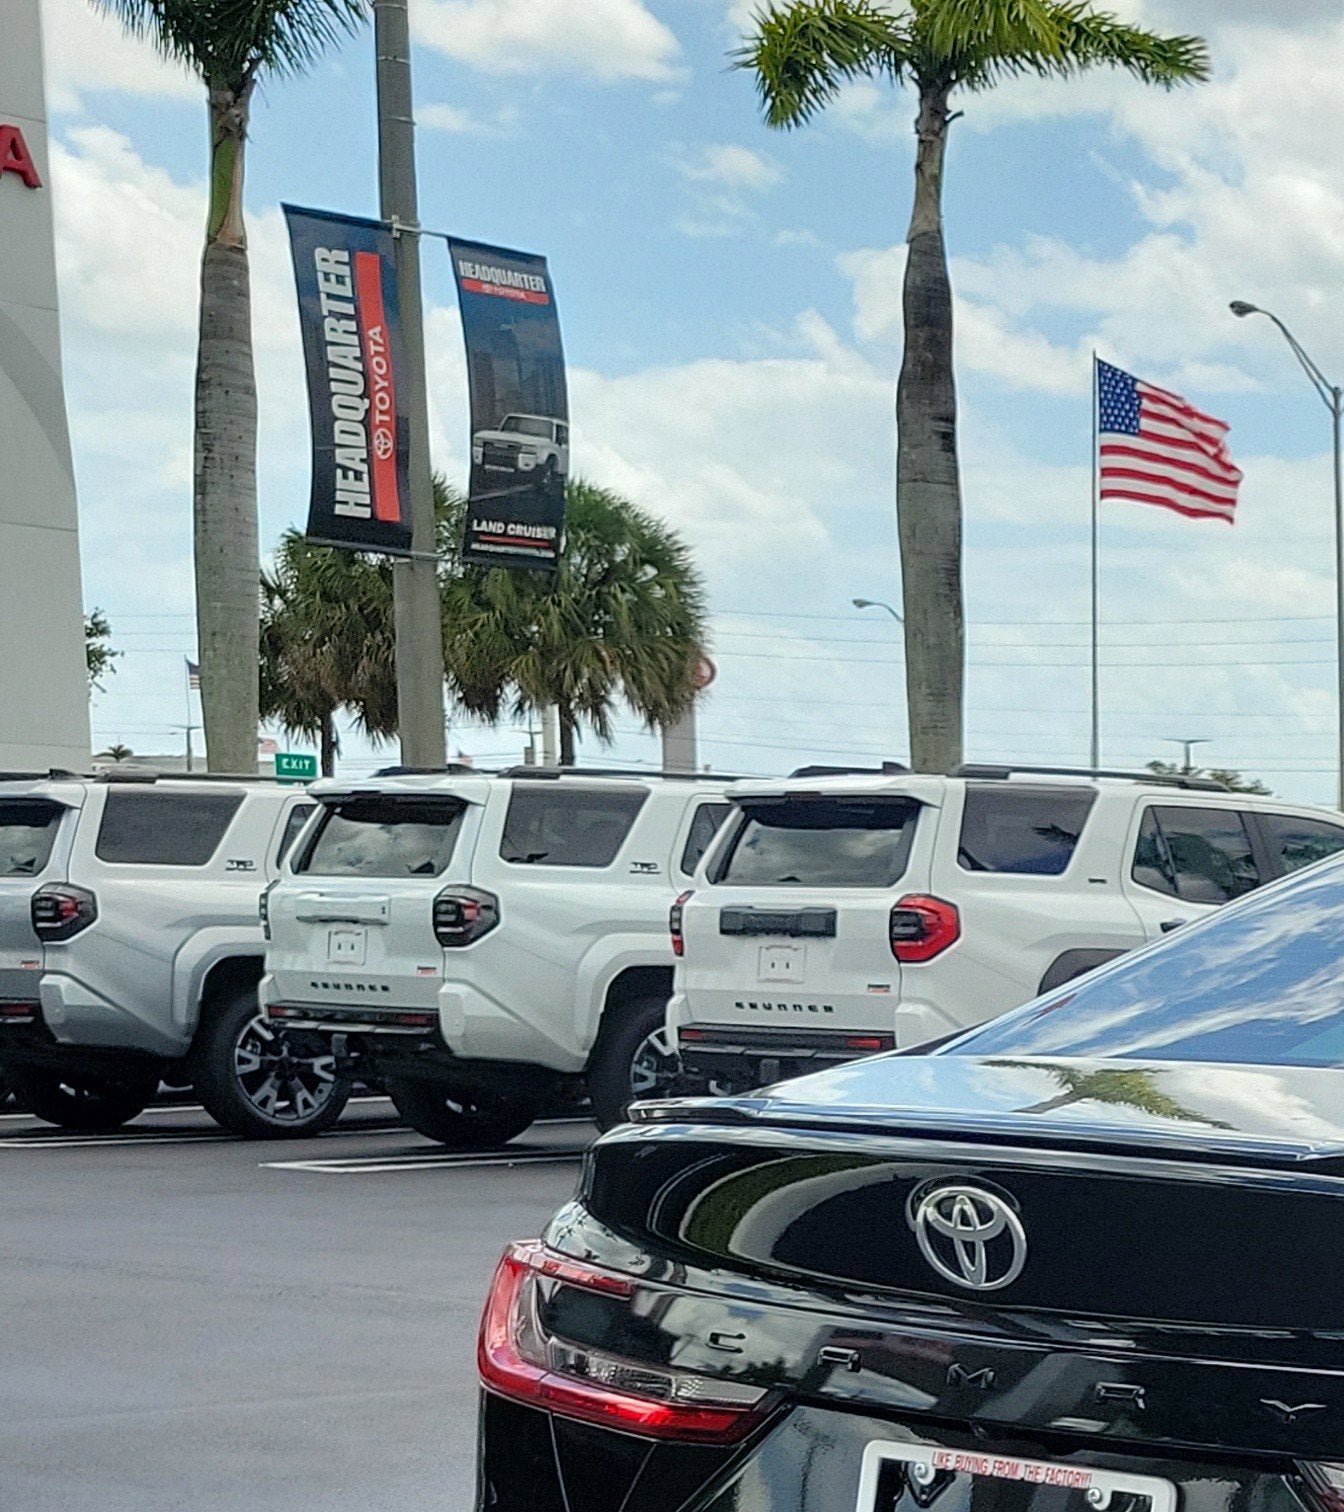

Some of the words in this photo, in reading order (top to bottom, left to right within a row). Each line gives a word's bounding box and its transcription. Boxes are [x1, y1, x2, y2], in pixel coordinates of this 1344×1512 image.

[458, 260, 547, 293] HEADQUARTER
[315, 246, 372, 519] HEADQUARTER
[367, 325, 391, 424] TOYOTA
[472, 519, 505, 534] LAND
[507, 523, 557, 540] CRUISER
[281, 757, 311, 770] EXIT
[932, 1450, 951, 1469] LIKE
[954, 1454, 989, 1474] BUYING
[992, 1460, 1019, 1478] FROM
[1023, 1464, 1041, 1482] THE
